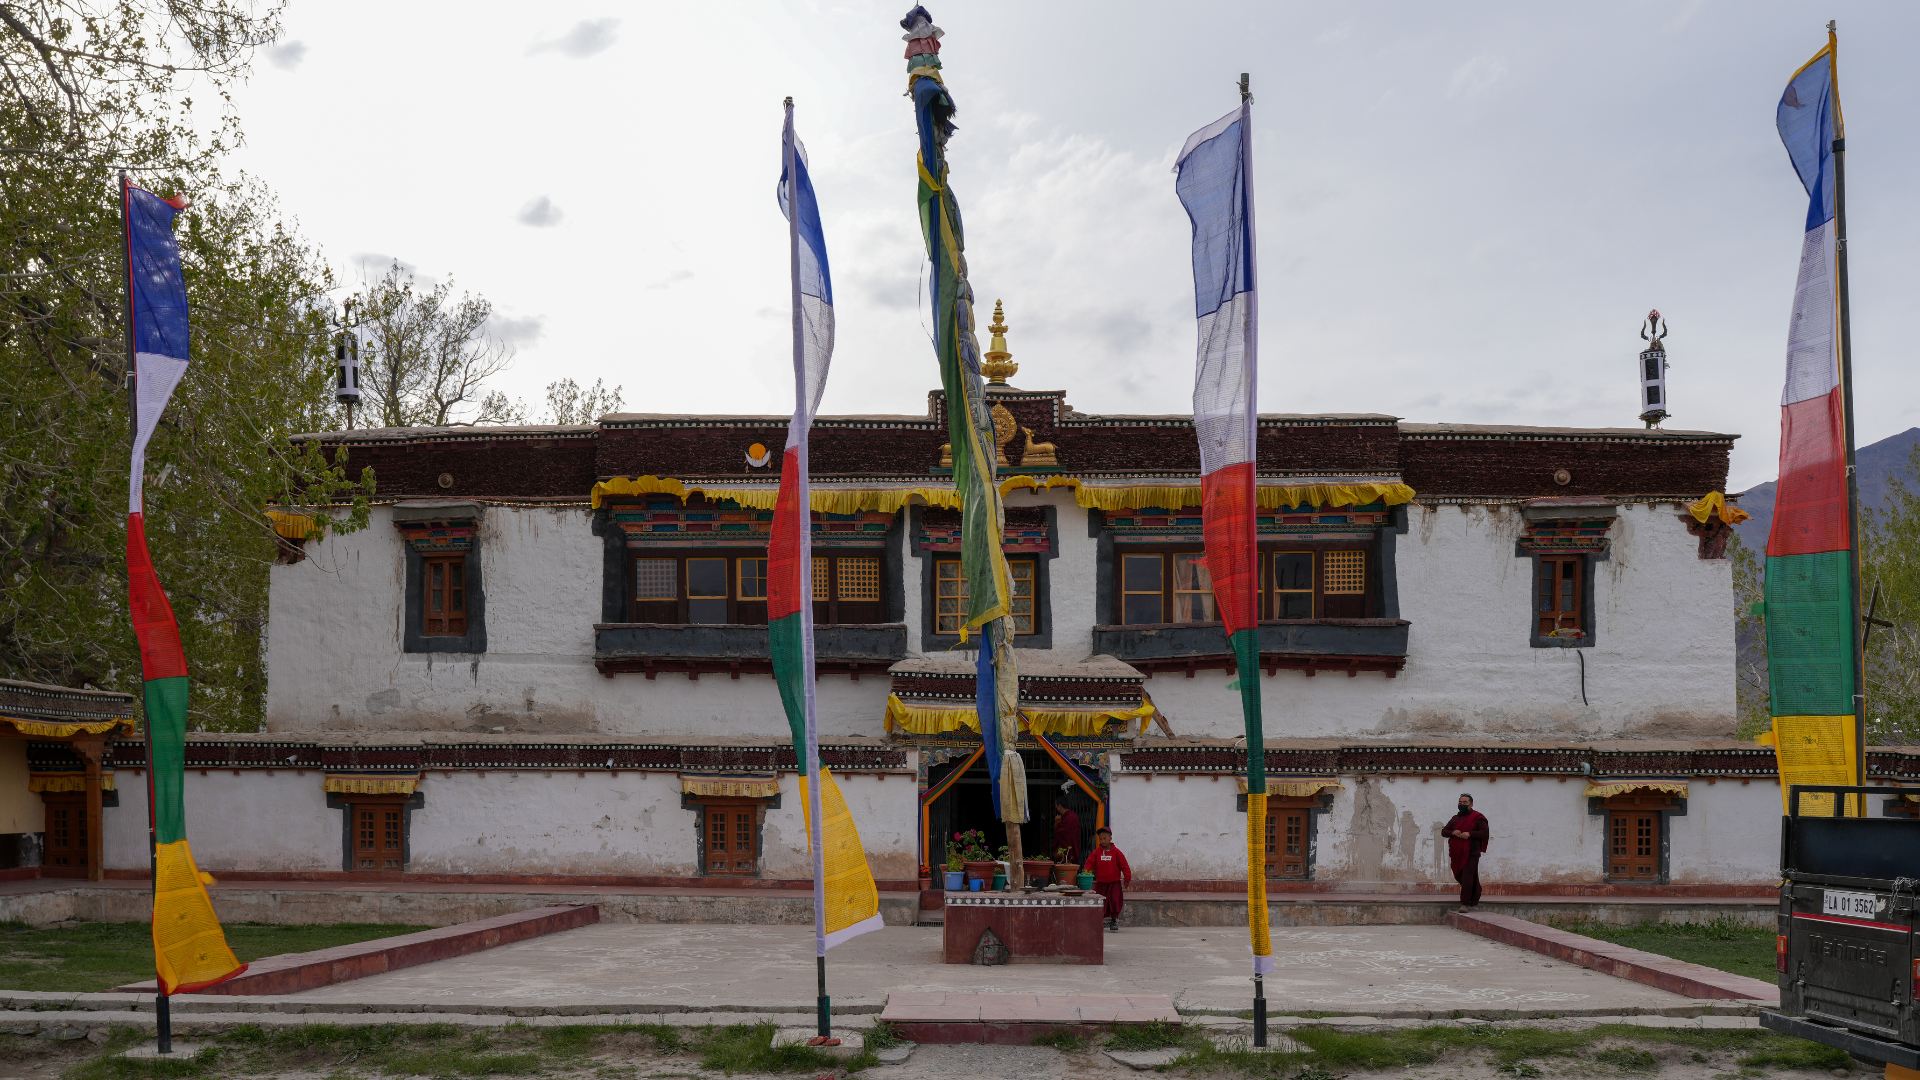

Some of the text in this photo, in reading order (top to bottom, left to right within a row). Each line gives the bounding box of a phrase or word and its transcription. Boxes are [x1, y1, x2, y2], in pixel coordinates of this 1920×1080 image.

[1829, 896, 1838, 910] LA
[1842, 897, 1850, 912] 01
[1855, 898, 1874, 914] 3562
